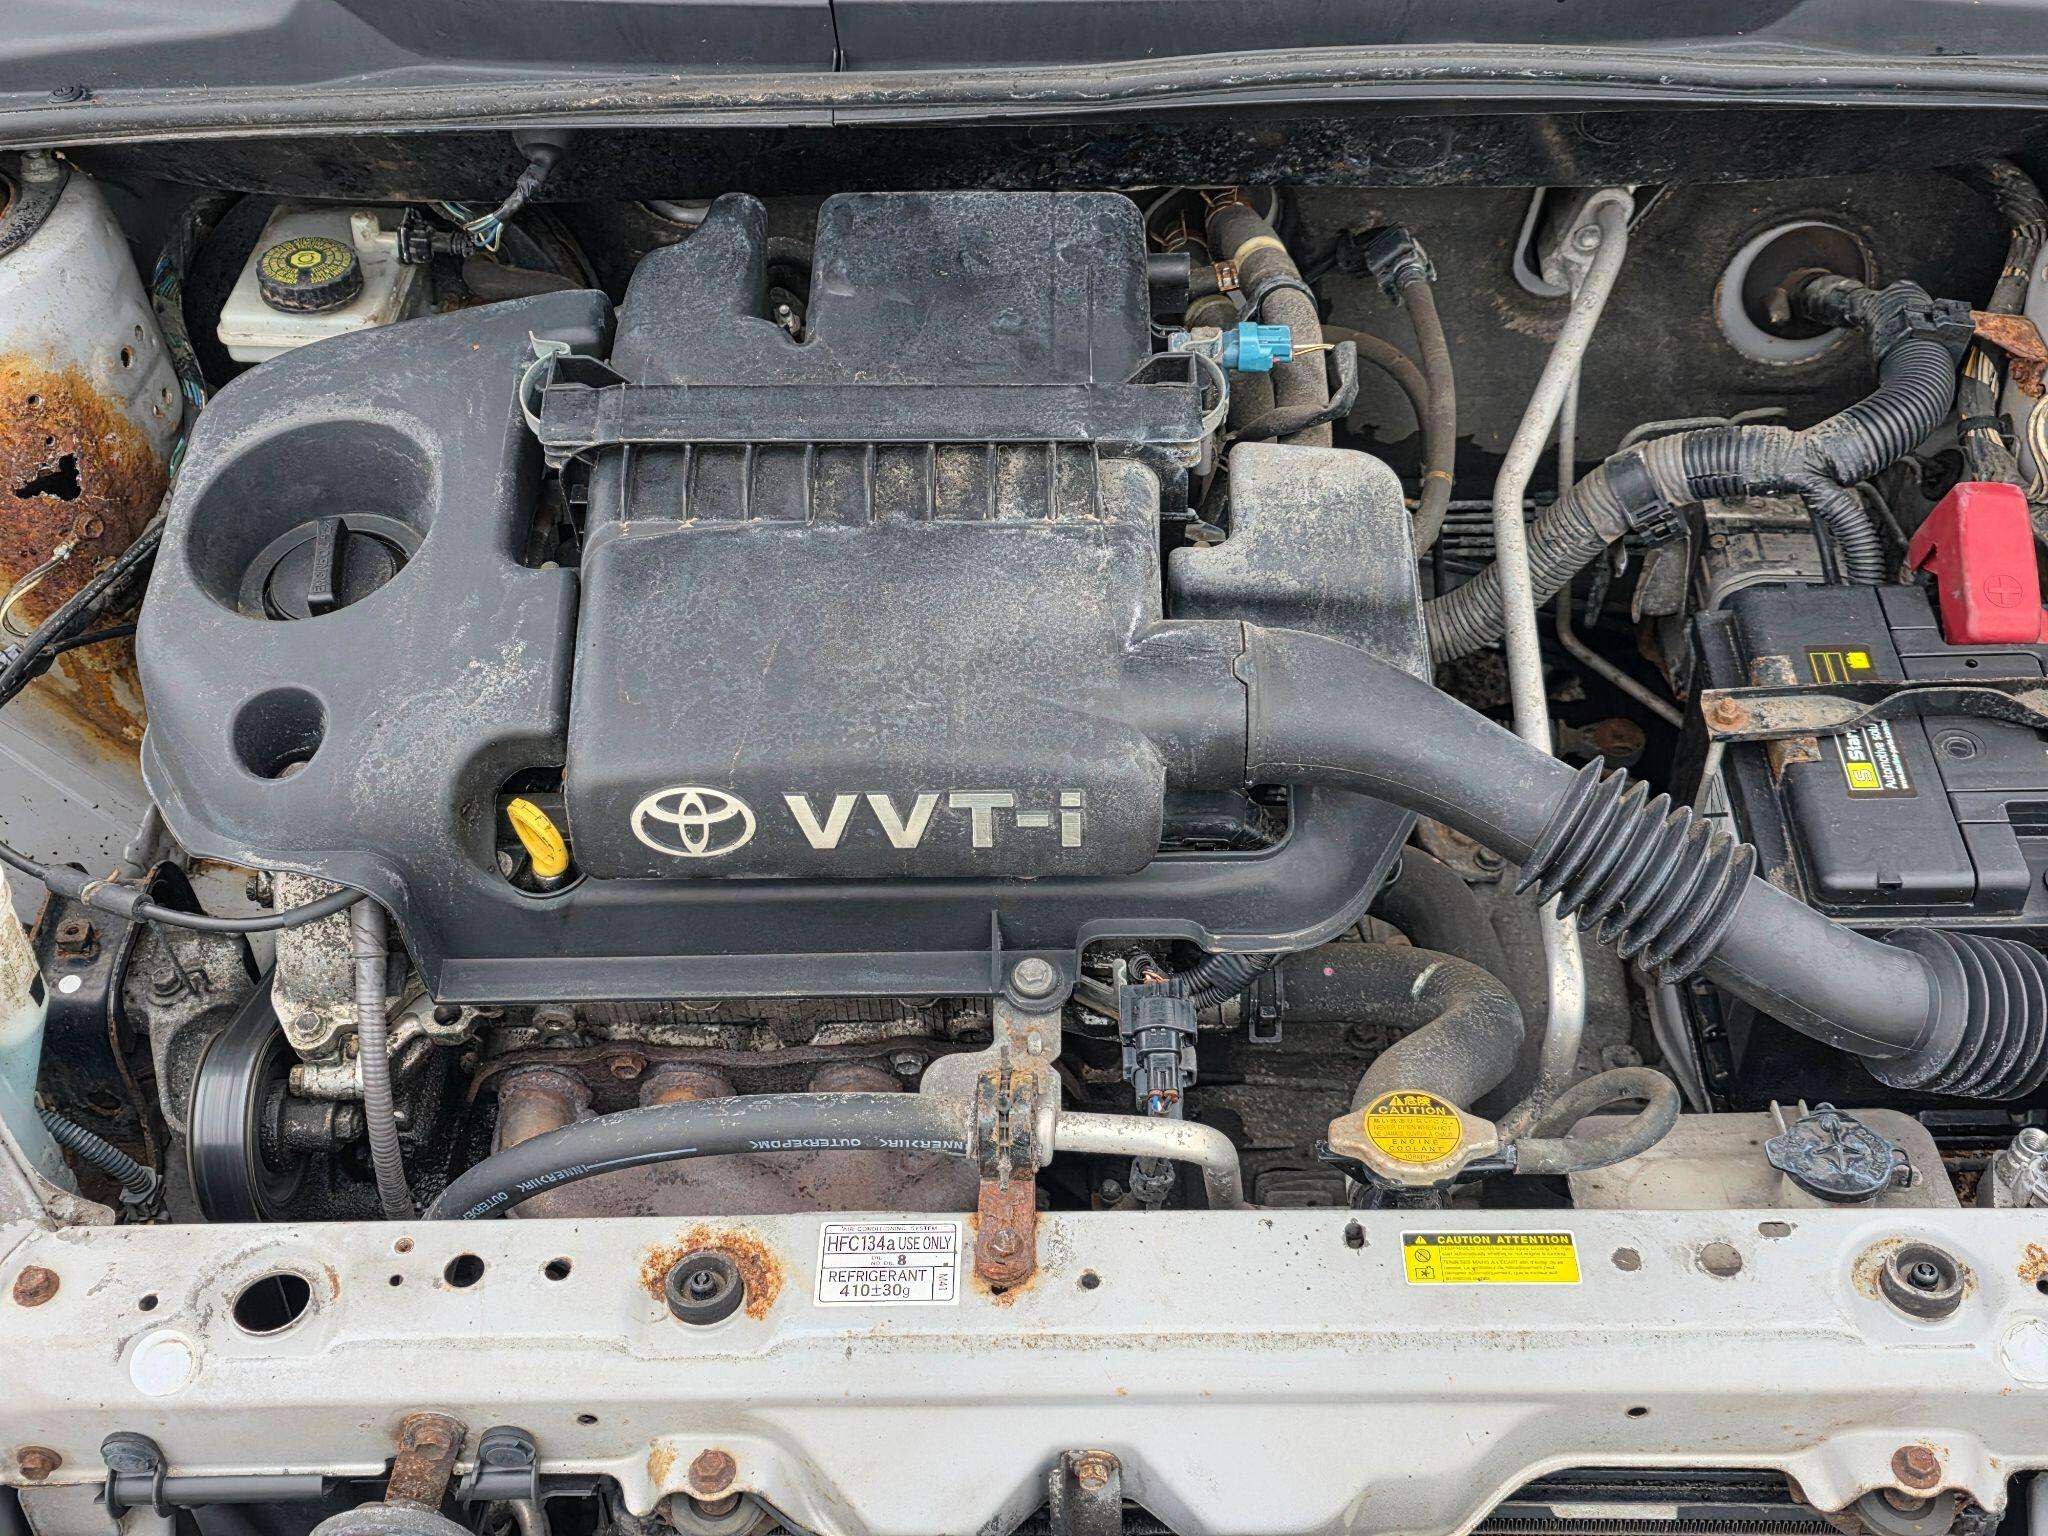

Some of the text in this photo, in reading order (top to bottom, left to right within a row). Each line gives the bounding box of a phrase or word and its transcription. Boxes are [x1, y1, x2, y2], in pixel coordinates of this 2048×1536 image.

[1846, 729, 1867, 761] Star
[1873, 741, 1899, 789] Automotive
[784, 791, 1082, 849] VVT-i
[1378, 1105, 1447, 1115] CAUTION
[1388, 1145, 1446, 1153] COOLANT
[828, 1235, 952, 1252] HFC134a USE ONLY
[1437, 1235, 1570, 1245] CAUTION ATTENTION
[828, 1269, 927, 1283] REFRIGERANT
[839, 1283, 911, 1298] 410±30g
